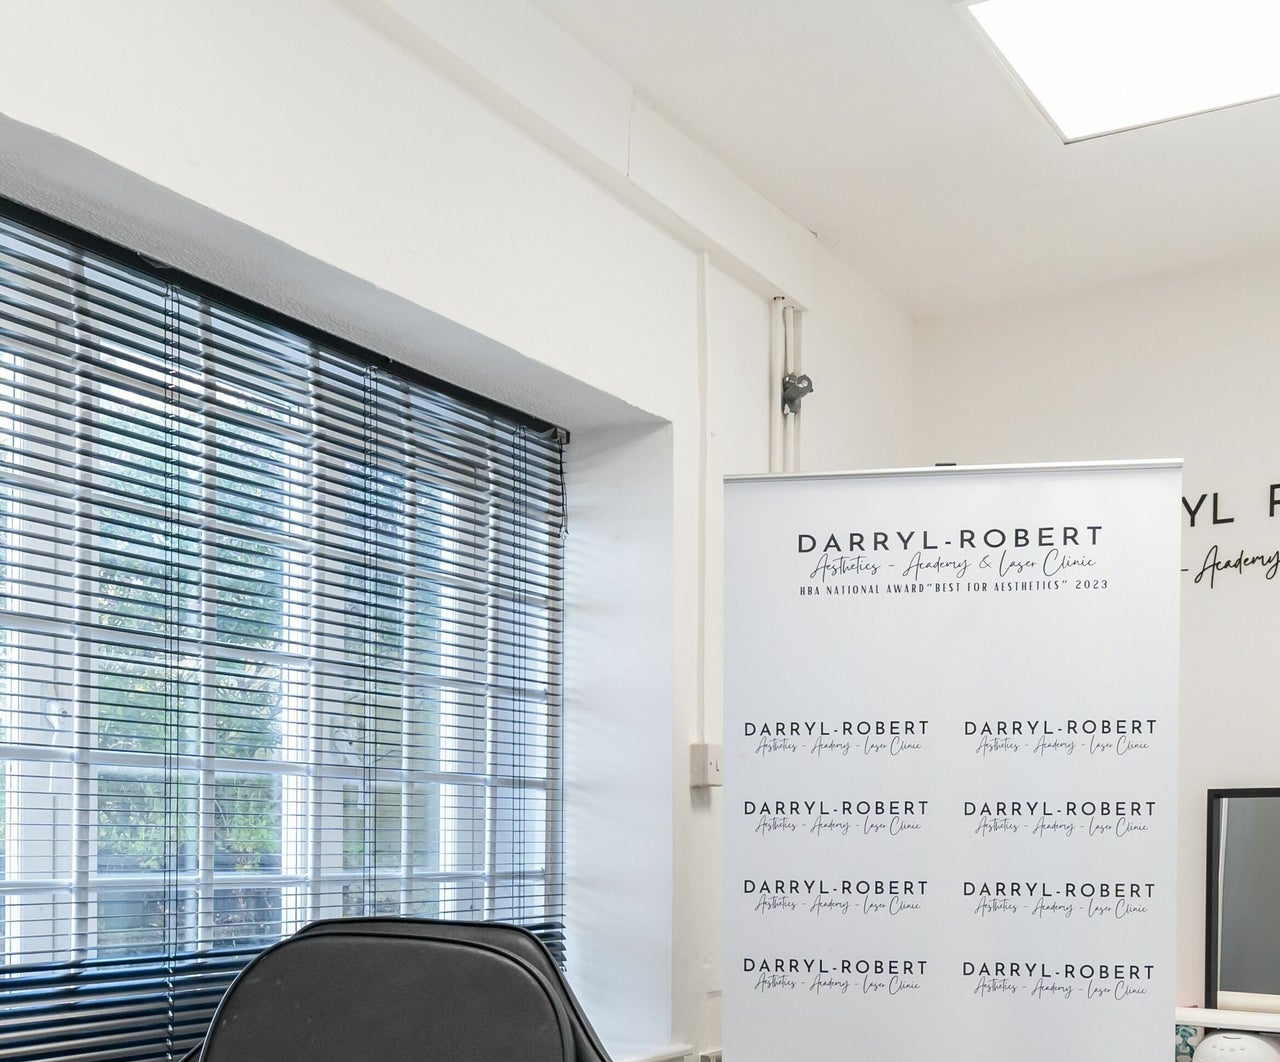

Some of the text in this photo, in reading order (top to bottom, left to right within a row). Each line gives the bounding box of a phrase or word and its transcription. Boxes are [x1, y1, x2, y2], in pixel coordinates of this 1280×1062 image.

[797, 526, 1103, 553] DARRYL-ROBERT
[809, 548, 1097, 583] Aesthetics Academy & Laser Clinic
[799, 586, 820, 596] HBA
[826, 584, 880, 595] NATIONAL
[967, 582, 988, 592] FOR
[1075, 579, 1108, 590] 2023
[744, 720, 929, 737] DARRYL-ROBERT
[964, 719, 1157, 736] DARRYL-ROBERT
[754, 736, 922, 757] Aesthetics Academy Laser Clinic
[975, 735, 1150, 756] Aesthetics Academy Laser Clinic
[744, 800, 928, 815] DARRYL-ROBERT
[964, 801, 1156, 816] DARRYL-ROBERT
[754, 815, 922, 836] Aesthetics Academy Laser Clinic
[974, 816, 1149, 837] Aesthetics Academy Laser Clinic
[744, 879, 928, 895] DARRYL-ROBERT
[963, 881, 1155, 898] DARRYL-ROBERT
[754, 894, 921, 915] Aesthetics Academy Laser Clinic
[973, 897, 1148, 919] Aesthetics Academy Laser Clinic
[743, 958, 927, 975] DARRYL-ROBERT
[963, 961, 1154, 980] DARRYL-ROBERT
[753, 973, 921, 995] Aesthetics Academy Laser Clinic
[973, 977, 1148, 1000] Aesthetics Academy Laser Clinic
